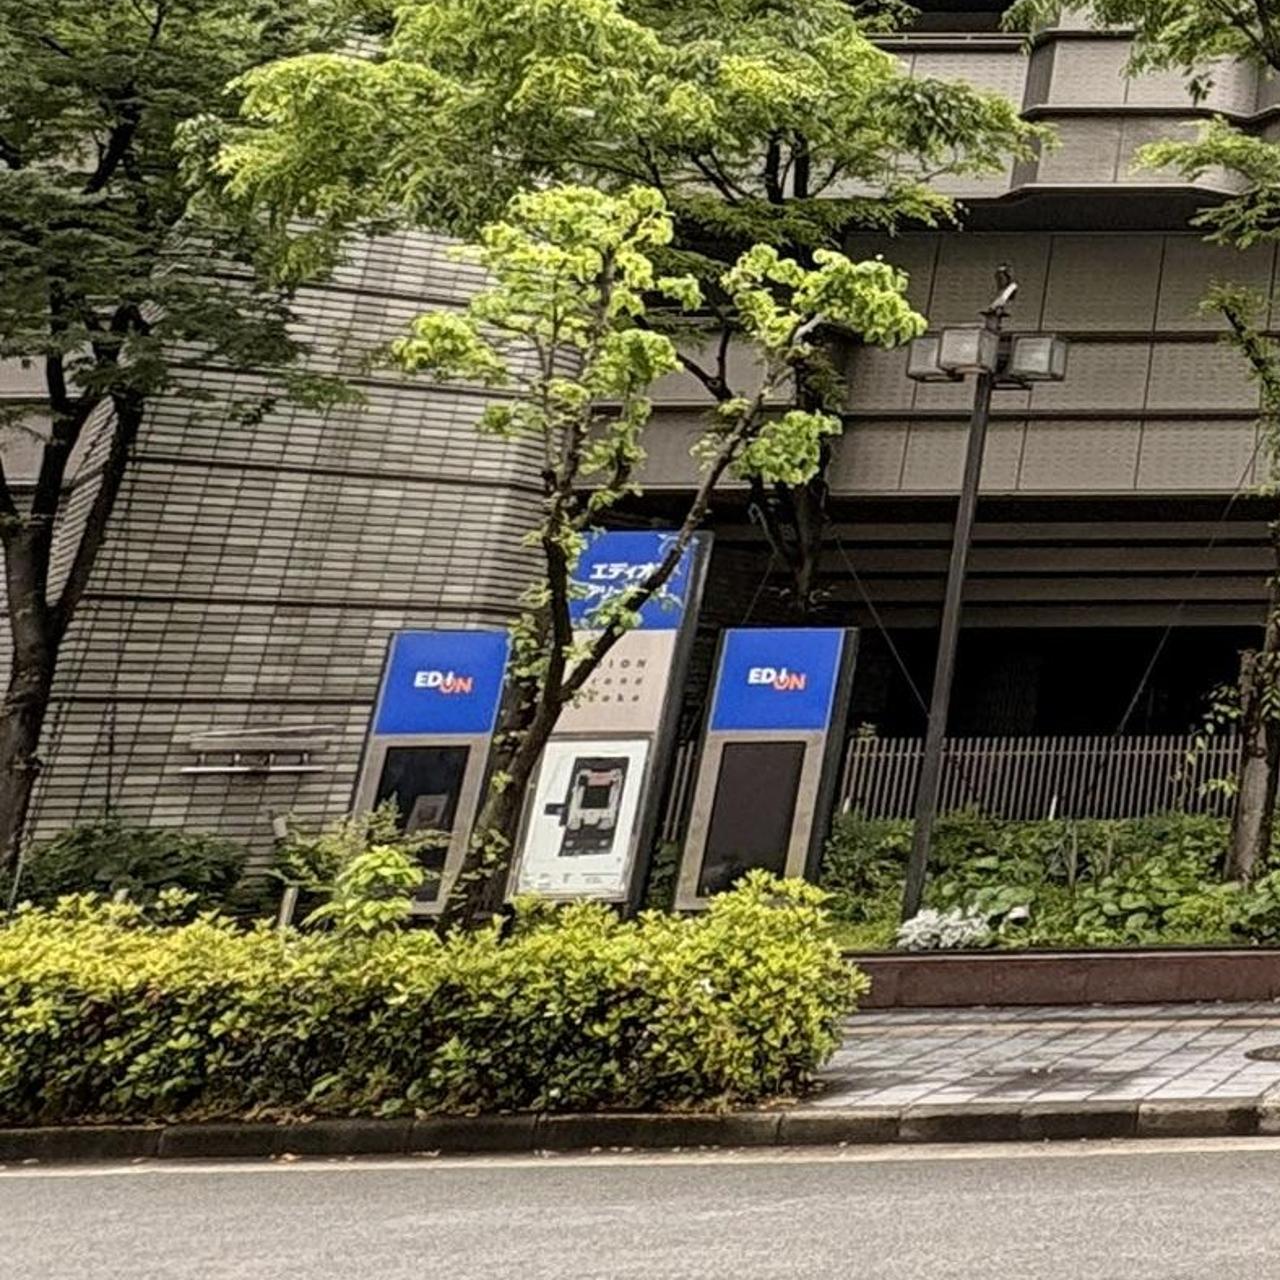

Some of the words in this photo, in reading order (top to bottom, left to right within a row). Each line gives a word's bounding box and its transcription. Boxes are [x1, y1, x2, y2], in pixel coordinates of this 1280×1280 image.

[589, 562, 664, 580] エディオ
[414, 670, 473, 693] EDION
[747, 667, 806, 690] EDION
